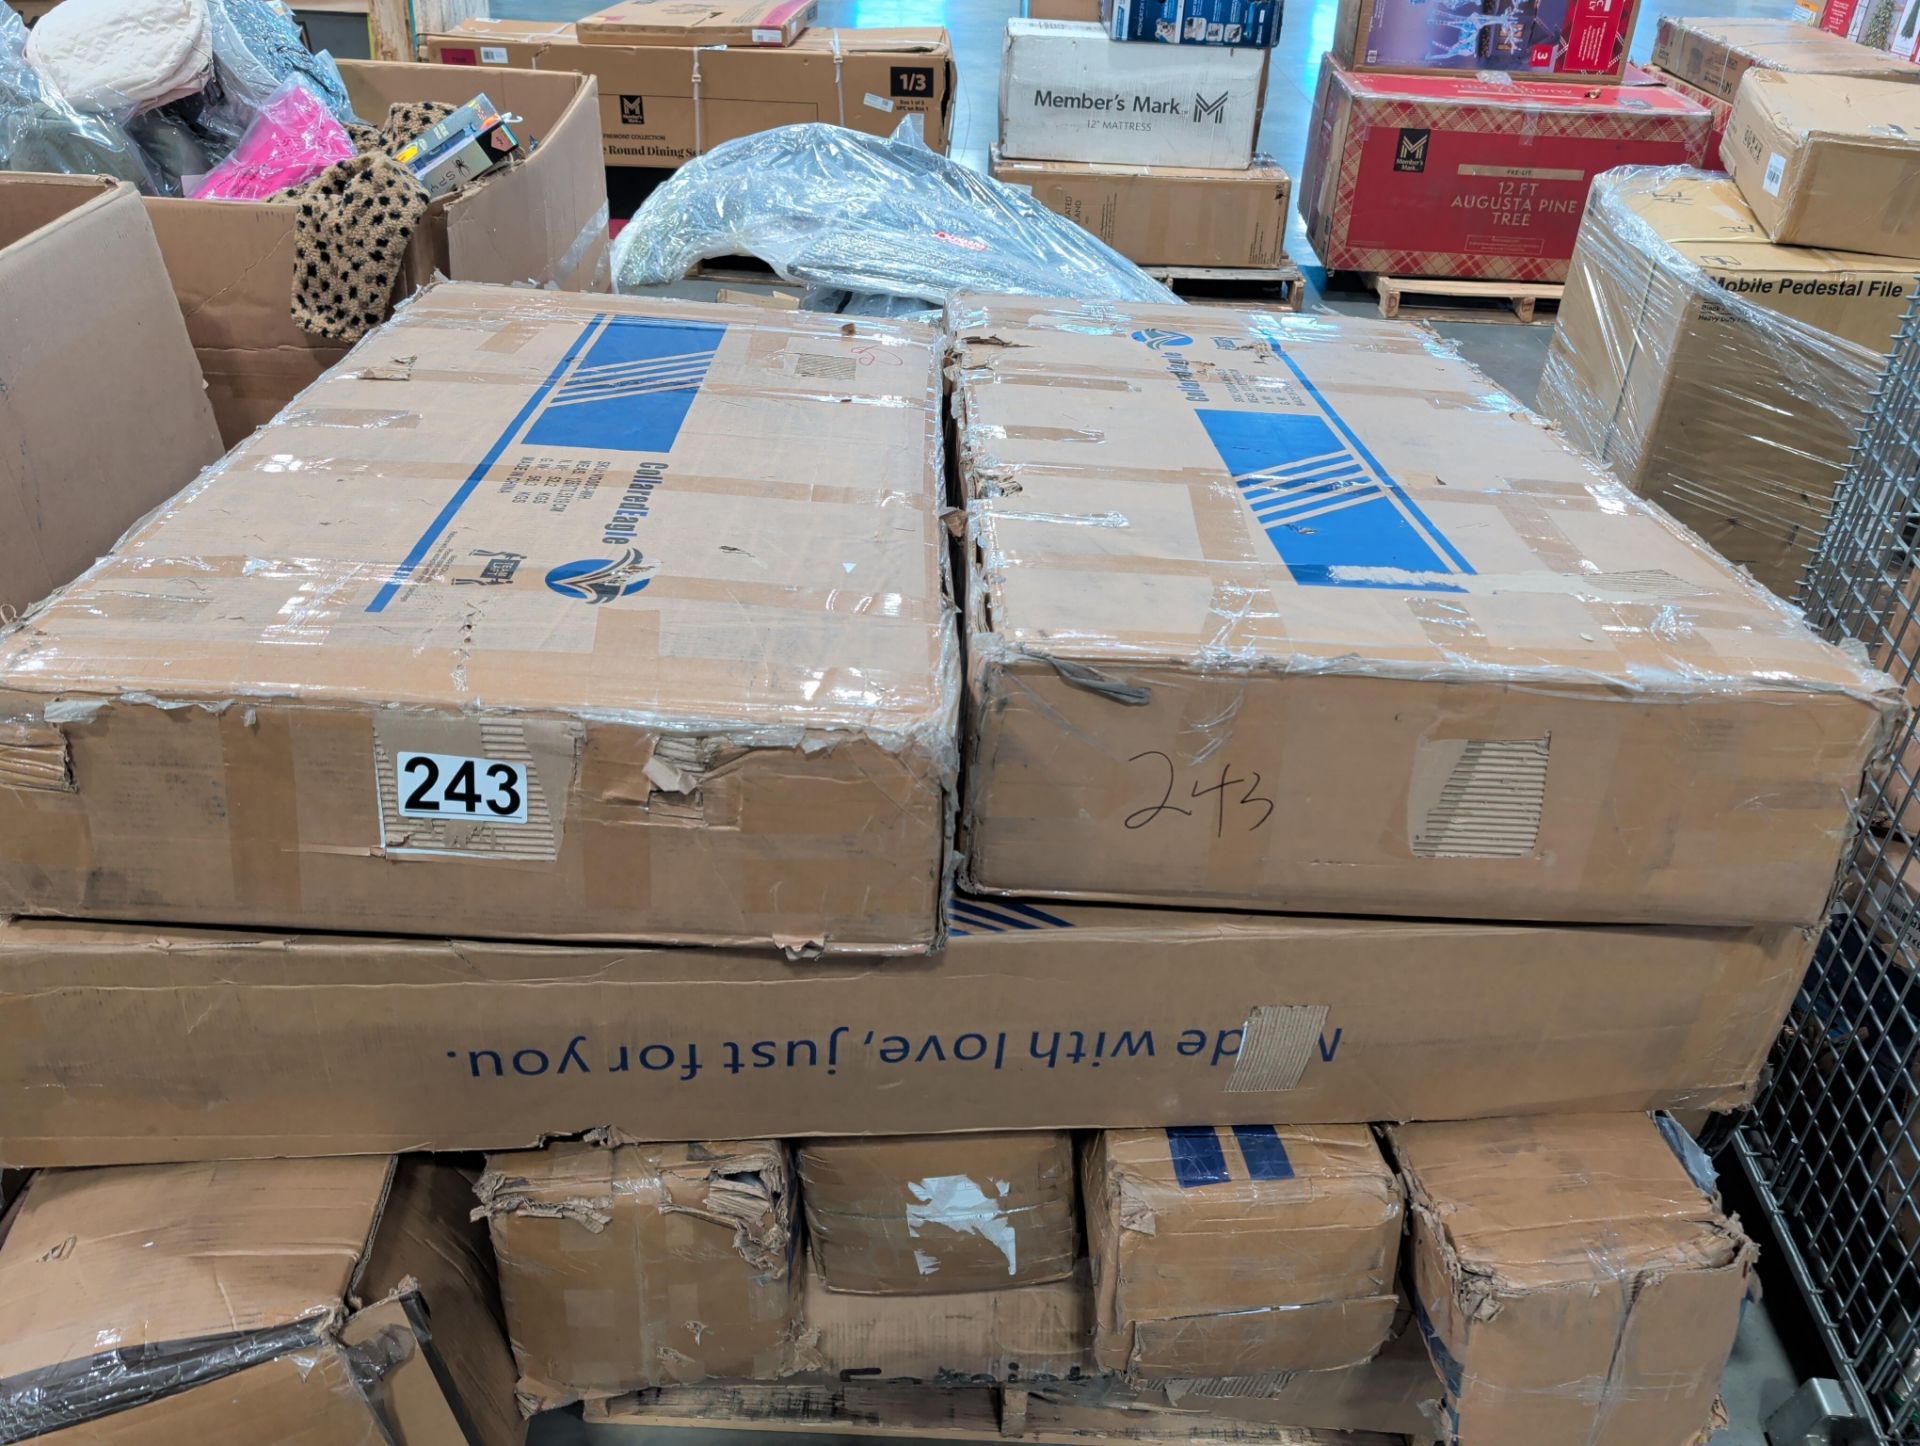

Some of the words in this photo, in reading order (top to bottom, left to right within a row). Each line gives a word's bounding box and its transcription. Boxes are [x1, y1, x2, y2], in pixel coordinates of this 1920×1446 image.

[900, 73, 927, 91] 1/3
[1034, 90, 1125, 111] Member's
[1132, 96, 1181, 114] Mark
[1103, 121, 1152, 132] MATTRESS
[608, 145, 645, 156] Round
[647, 147, 684, 159] Dining
[1450, 195, 1532, 211] AUGUSTA
[1538, 199, 1578, 214] PINE
[1498, 181, 1514, 195] 12
[1519, 183, 1539, 197] FT
[1492, 212, 1531, 226] TREE
[1709, 276, 1773, 294] Mobile
[1779, 278, 1863, 297] Pedestal
[1868, 281, 1903, 298] File
[602, 461, 669, 545] CollaredEagle
[404, 756, 521, 815] 243
[1125, 751, 1274, 838] 243
[446, 1035, 591, 1078] you.
[608, 1042, 703, 1081] for
[722, 1026, 849, 1076] just
[863, 1030, 1006, 1069] love,
[1030, 1029, 1156, 1068] with
[1176, 1028, 1343, 1067] Mde
